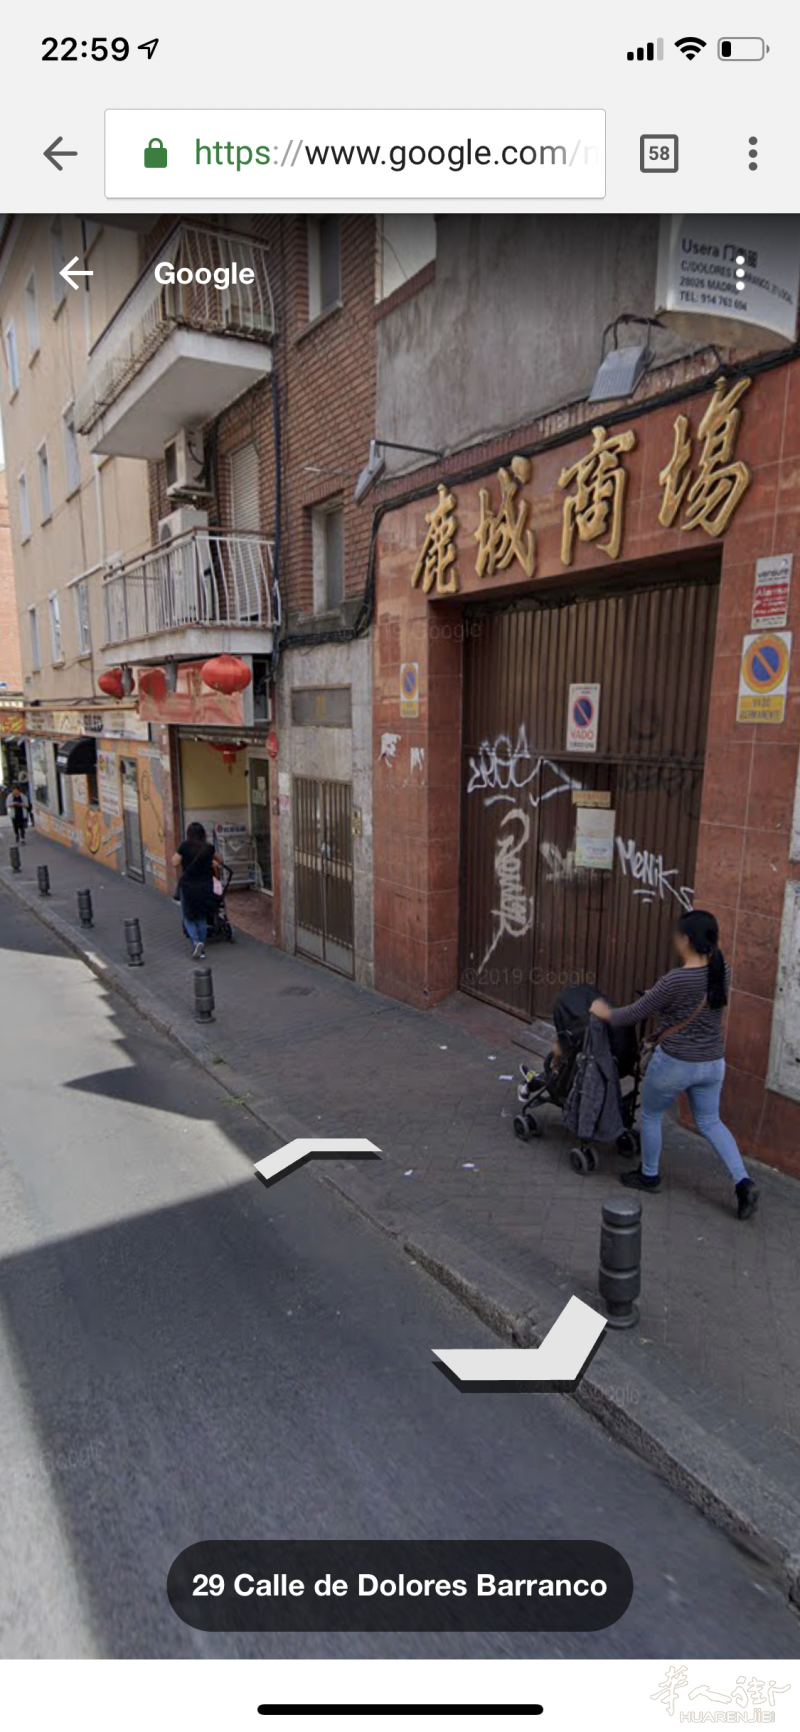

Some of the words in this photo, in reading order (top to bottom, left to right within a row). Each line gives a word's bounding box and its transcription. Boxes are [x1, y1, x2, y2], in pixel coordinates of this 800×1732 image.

[41, 36, 130, 62] 22:59
[649, 145, 670, 161] 58
[681, 239, 720, 257] Usera
[570, 729, 595, 741] VADO
